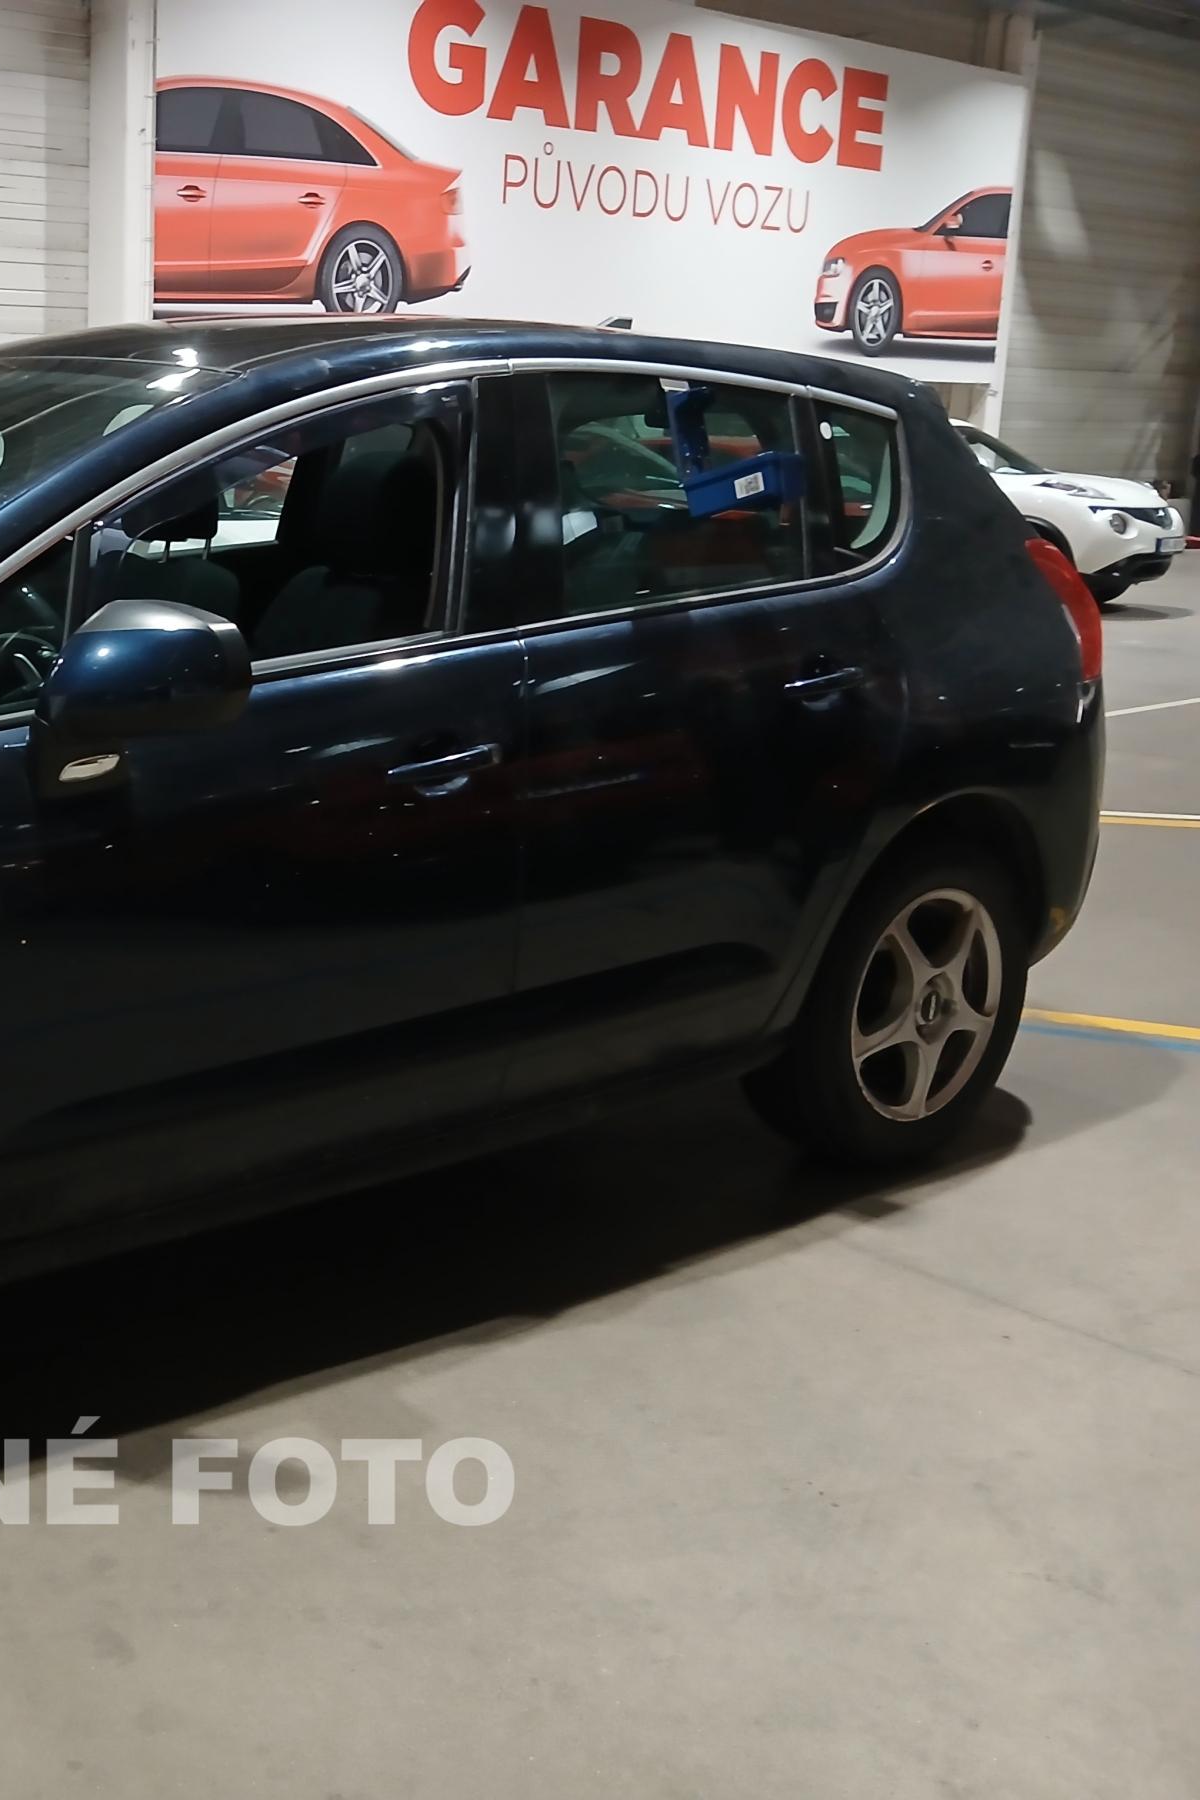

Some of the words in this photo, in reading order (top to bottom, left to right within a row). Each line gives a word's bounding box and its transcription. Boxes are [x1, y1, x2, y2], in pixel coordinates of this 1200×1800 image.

[408, 0, 888, 171] GARANCE
[502, 141, 690, 222] PŮVODU
[706, 178, 810, 233] VOZU
